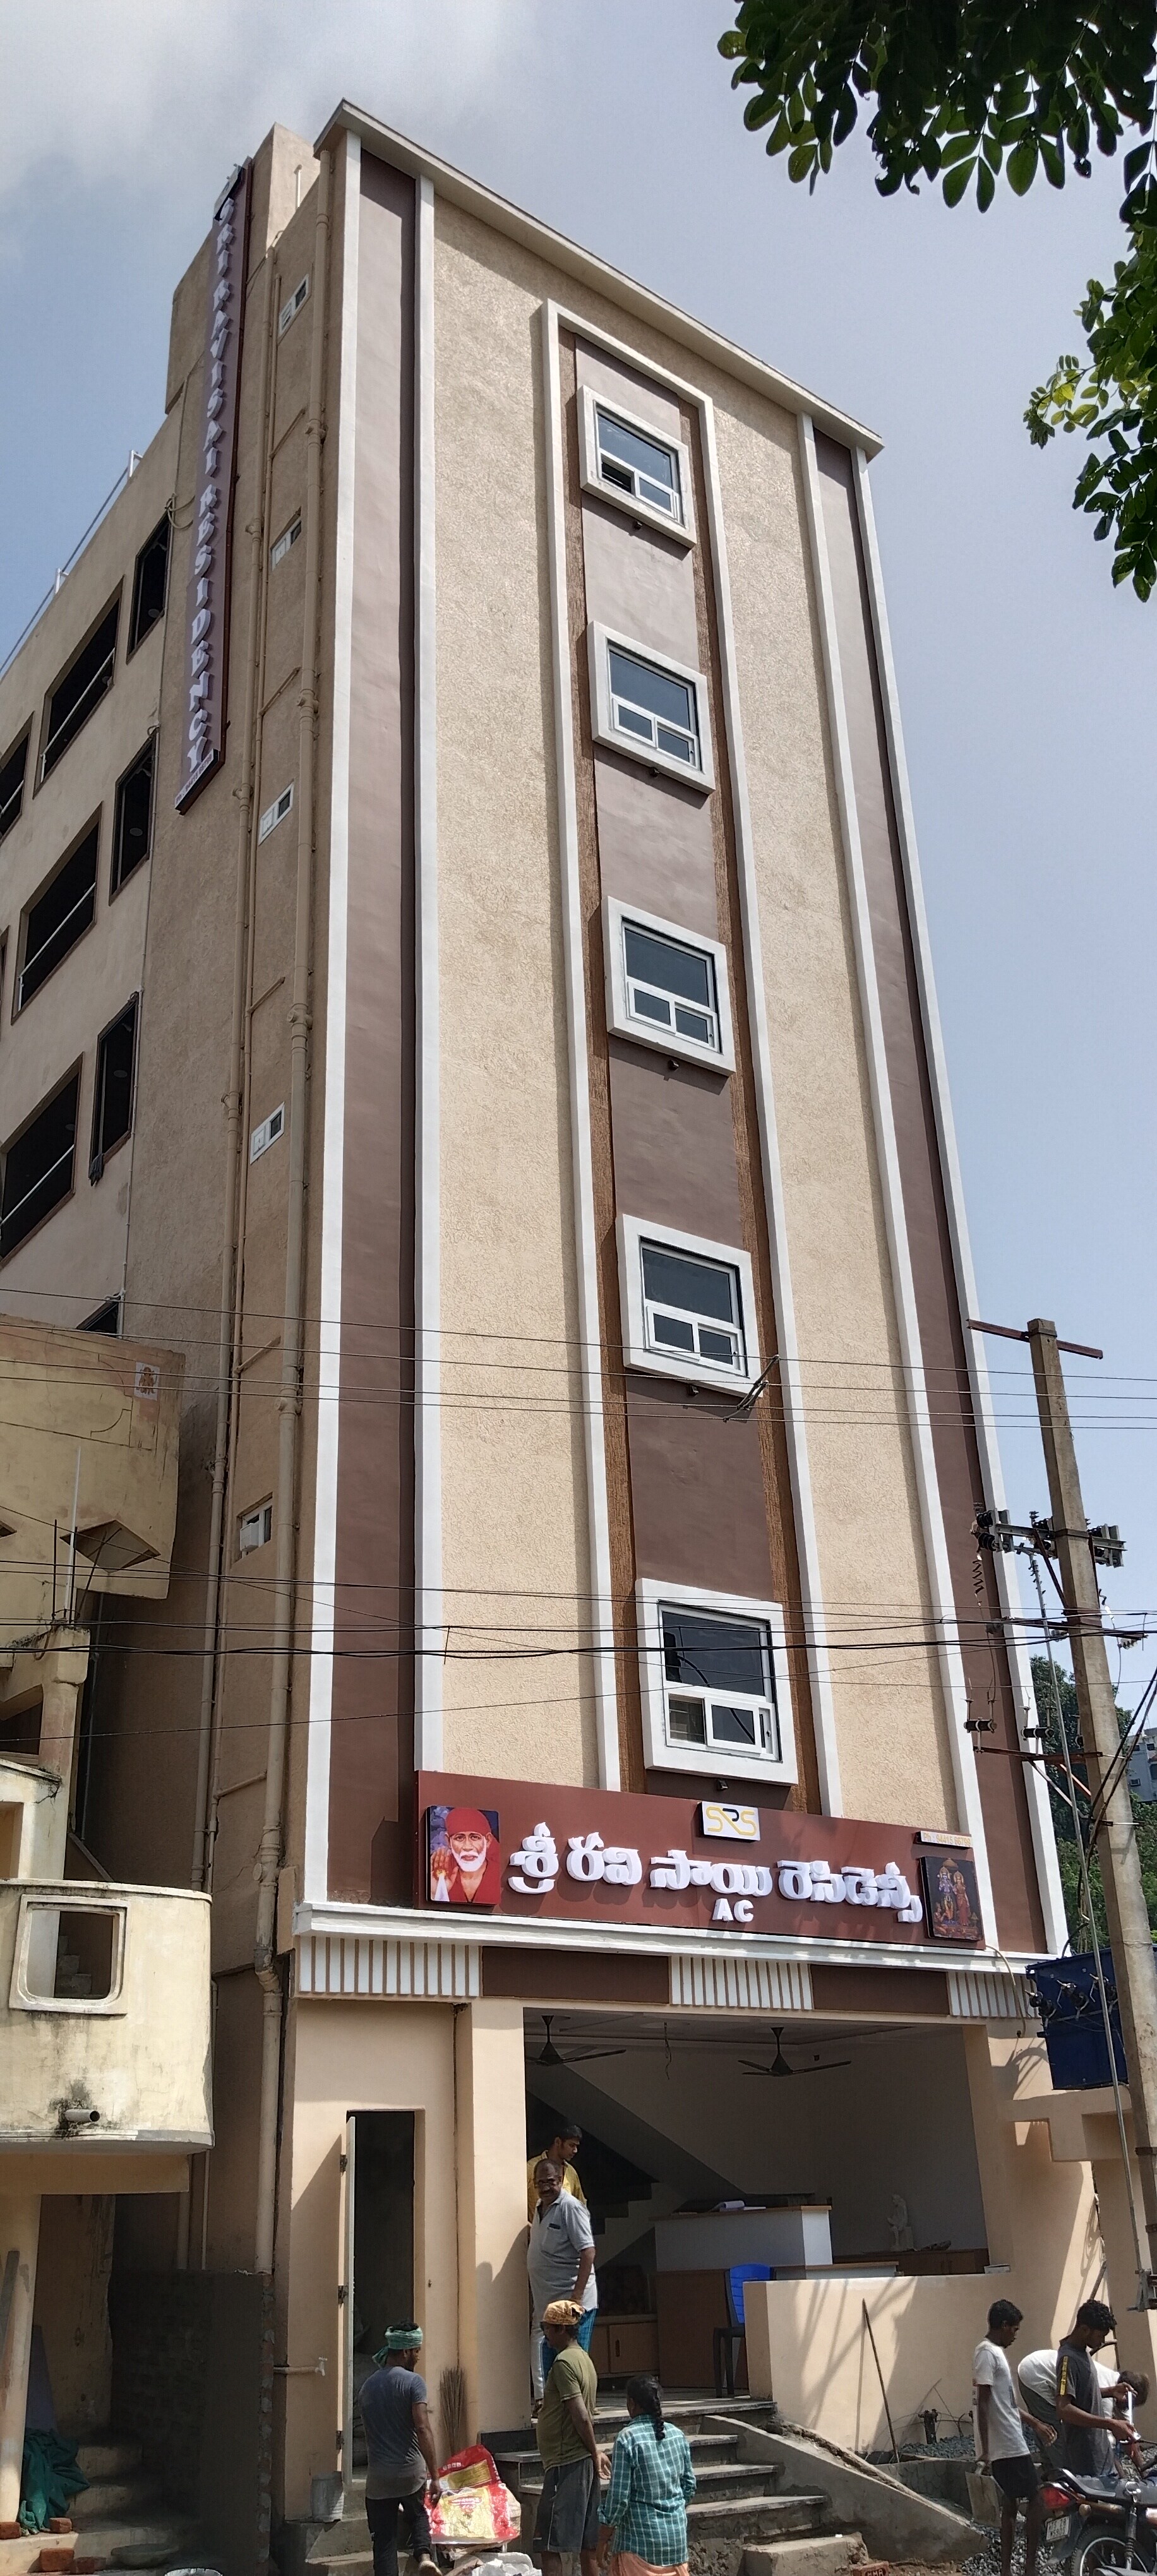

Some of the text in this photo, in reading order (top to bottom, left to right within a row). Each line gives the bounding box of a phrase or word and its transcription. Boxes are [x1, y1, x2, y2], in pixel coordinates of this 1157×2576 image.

[210, 279, 232, 389] RAVI
[203, 388, 224, 480] SAI
[187, 484, 217, 773] RESIDENCY
[508, 1822, 559, 1894] శ్రీ
[567, 1832, 642, 1886] రవి
[650, 1849, 773, 1897] సాయి
[706, 1806, 757, 1836] SRS
[712, 1898, 754, 1923] AC
